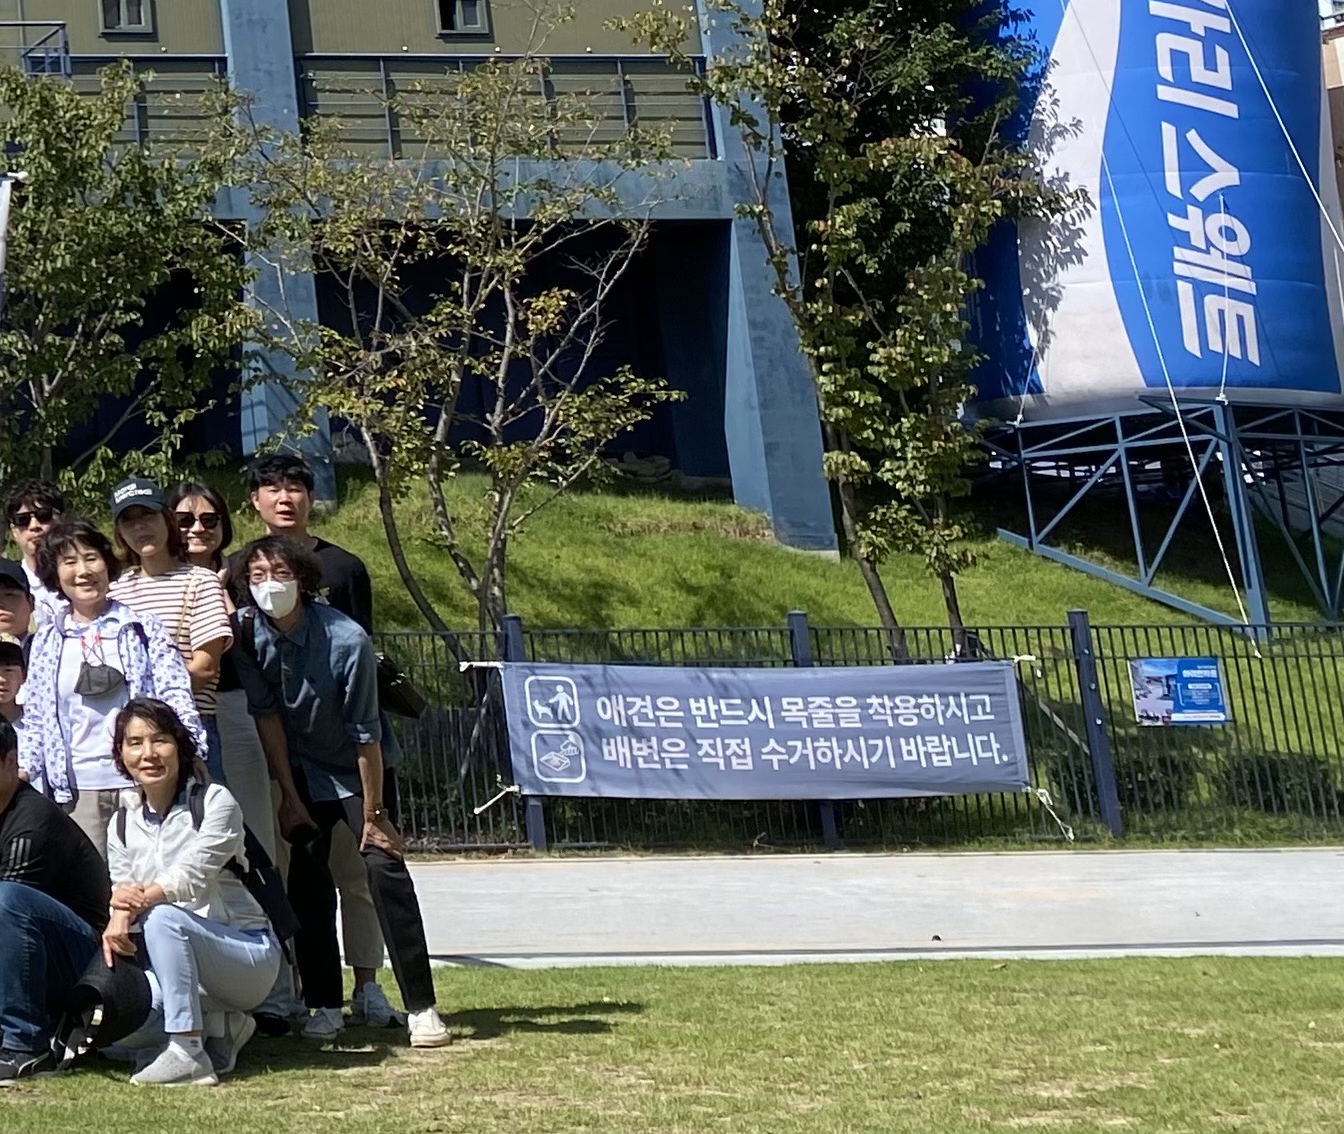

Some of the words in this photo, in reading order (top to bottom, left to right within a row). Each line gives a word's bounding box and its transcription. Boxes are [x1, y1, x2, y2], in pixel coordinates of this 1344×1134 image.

[596, 694, 684, 728] 애견은
[689, 695, 775, 729] 반드시
[781, 696, 862, 729] 목줄을
[866, 692, 995, 727] 착용하시고
[602, 736, 690, 769] 배변은
[697, 737, 753, 770] 직접
[761, 736, 896, 771] 수거하시기
[900, 732, 1009, 767] 바랍니다.
